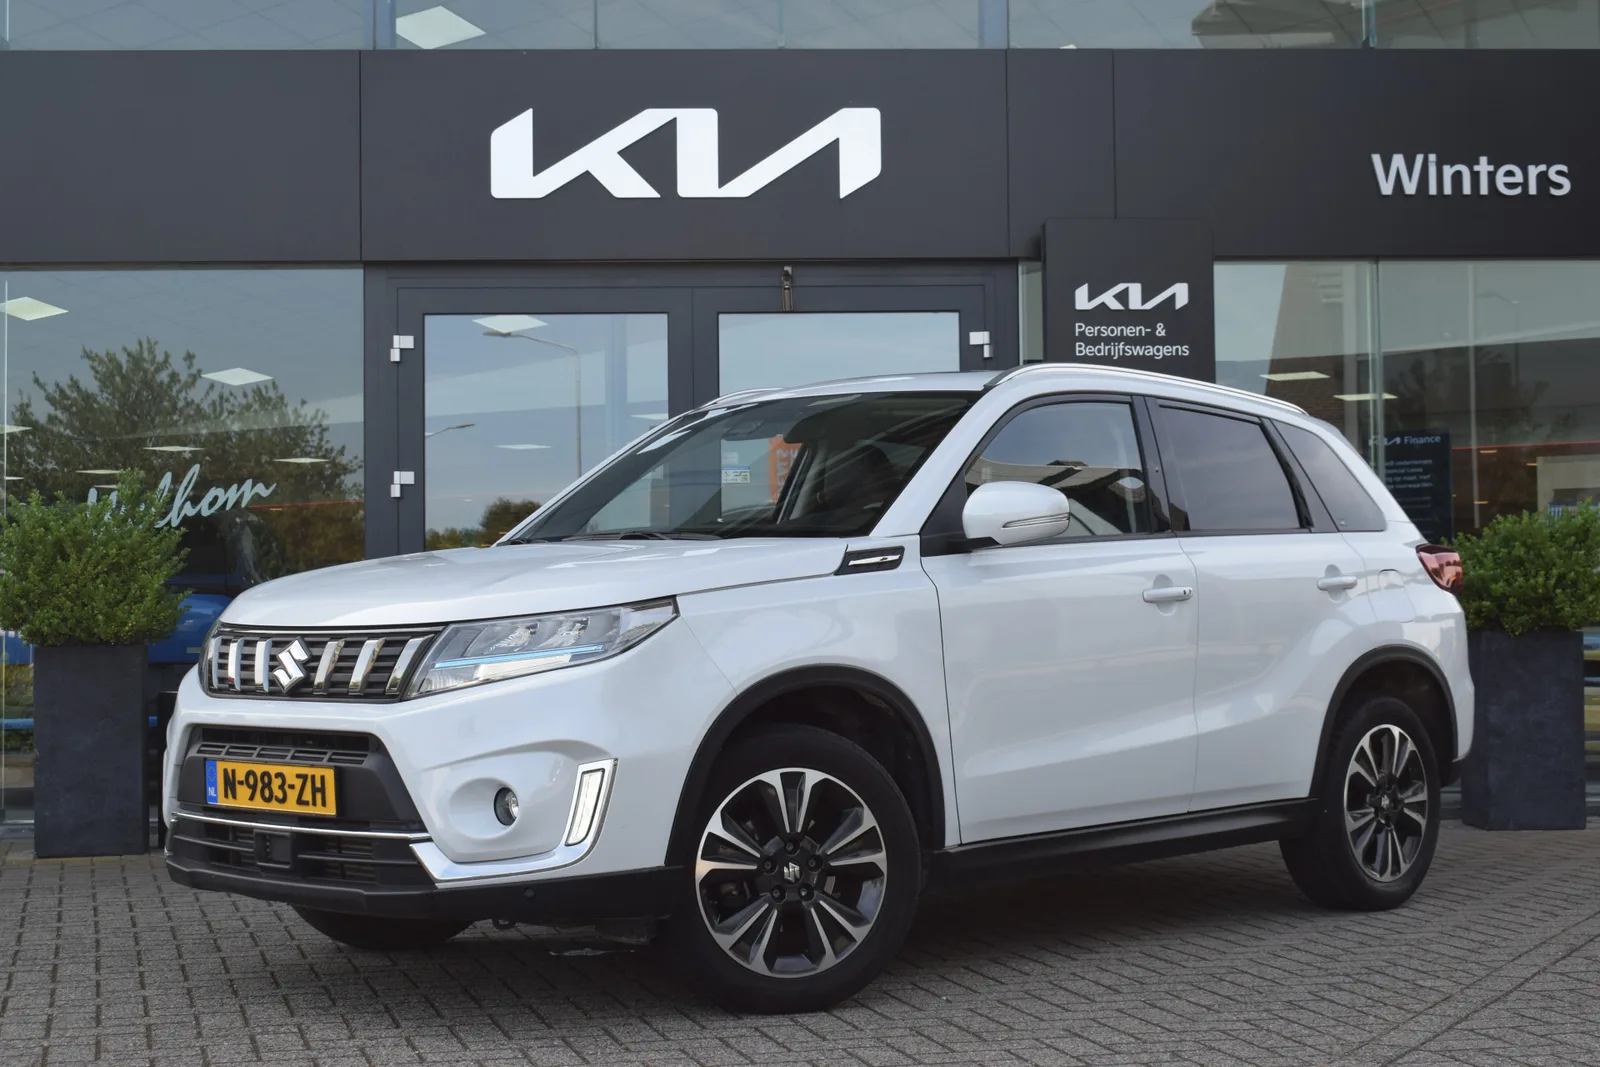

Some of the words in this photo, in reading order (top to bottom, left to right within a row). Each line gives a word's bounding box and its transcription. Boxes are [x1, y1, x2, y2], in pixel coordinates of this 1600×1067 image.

[490, 107, 882, 199] KIA
[1371, 153, 1571, 196] Winters
[1075, 282, 1189, 310] KIA
[1075, 322, 1152, 337] Personen-
[1155, 322, 1166, 337] &
[1075, 342, 1190, 359] Bedrijfswagens
[1404, 435, 1441, 445] Finance
[208, 786, 217, 797] NL
[223, 767, 327, 808] N-983-ZH
